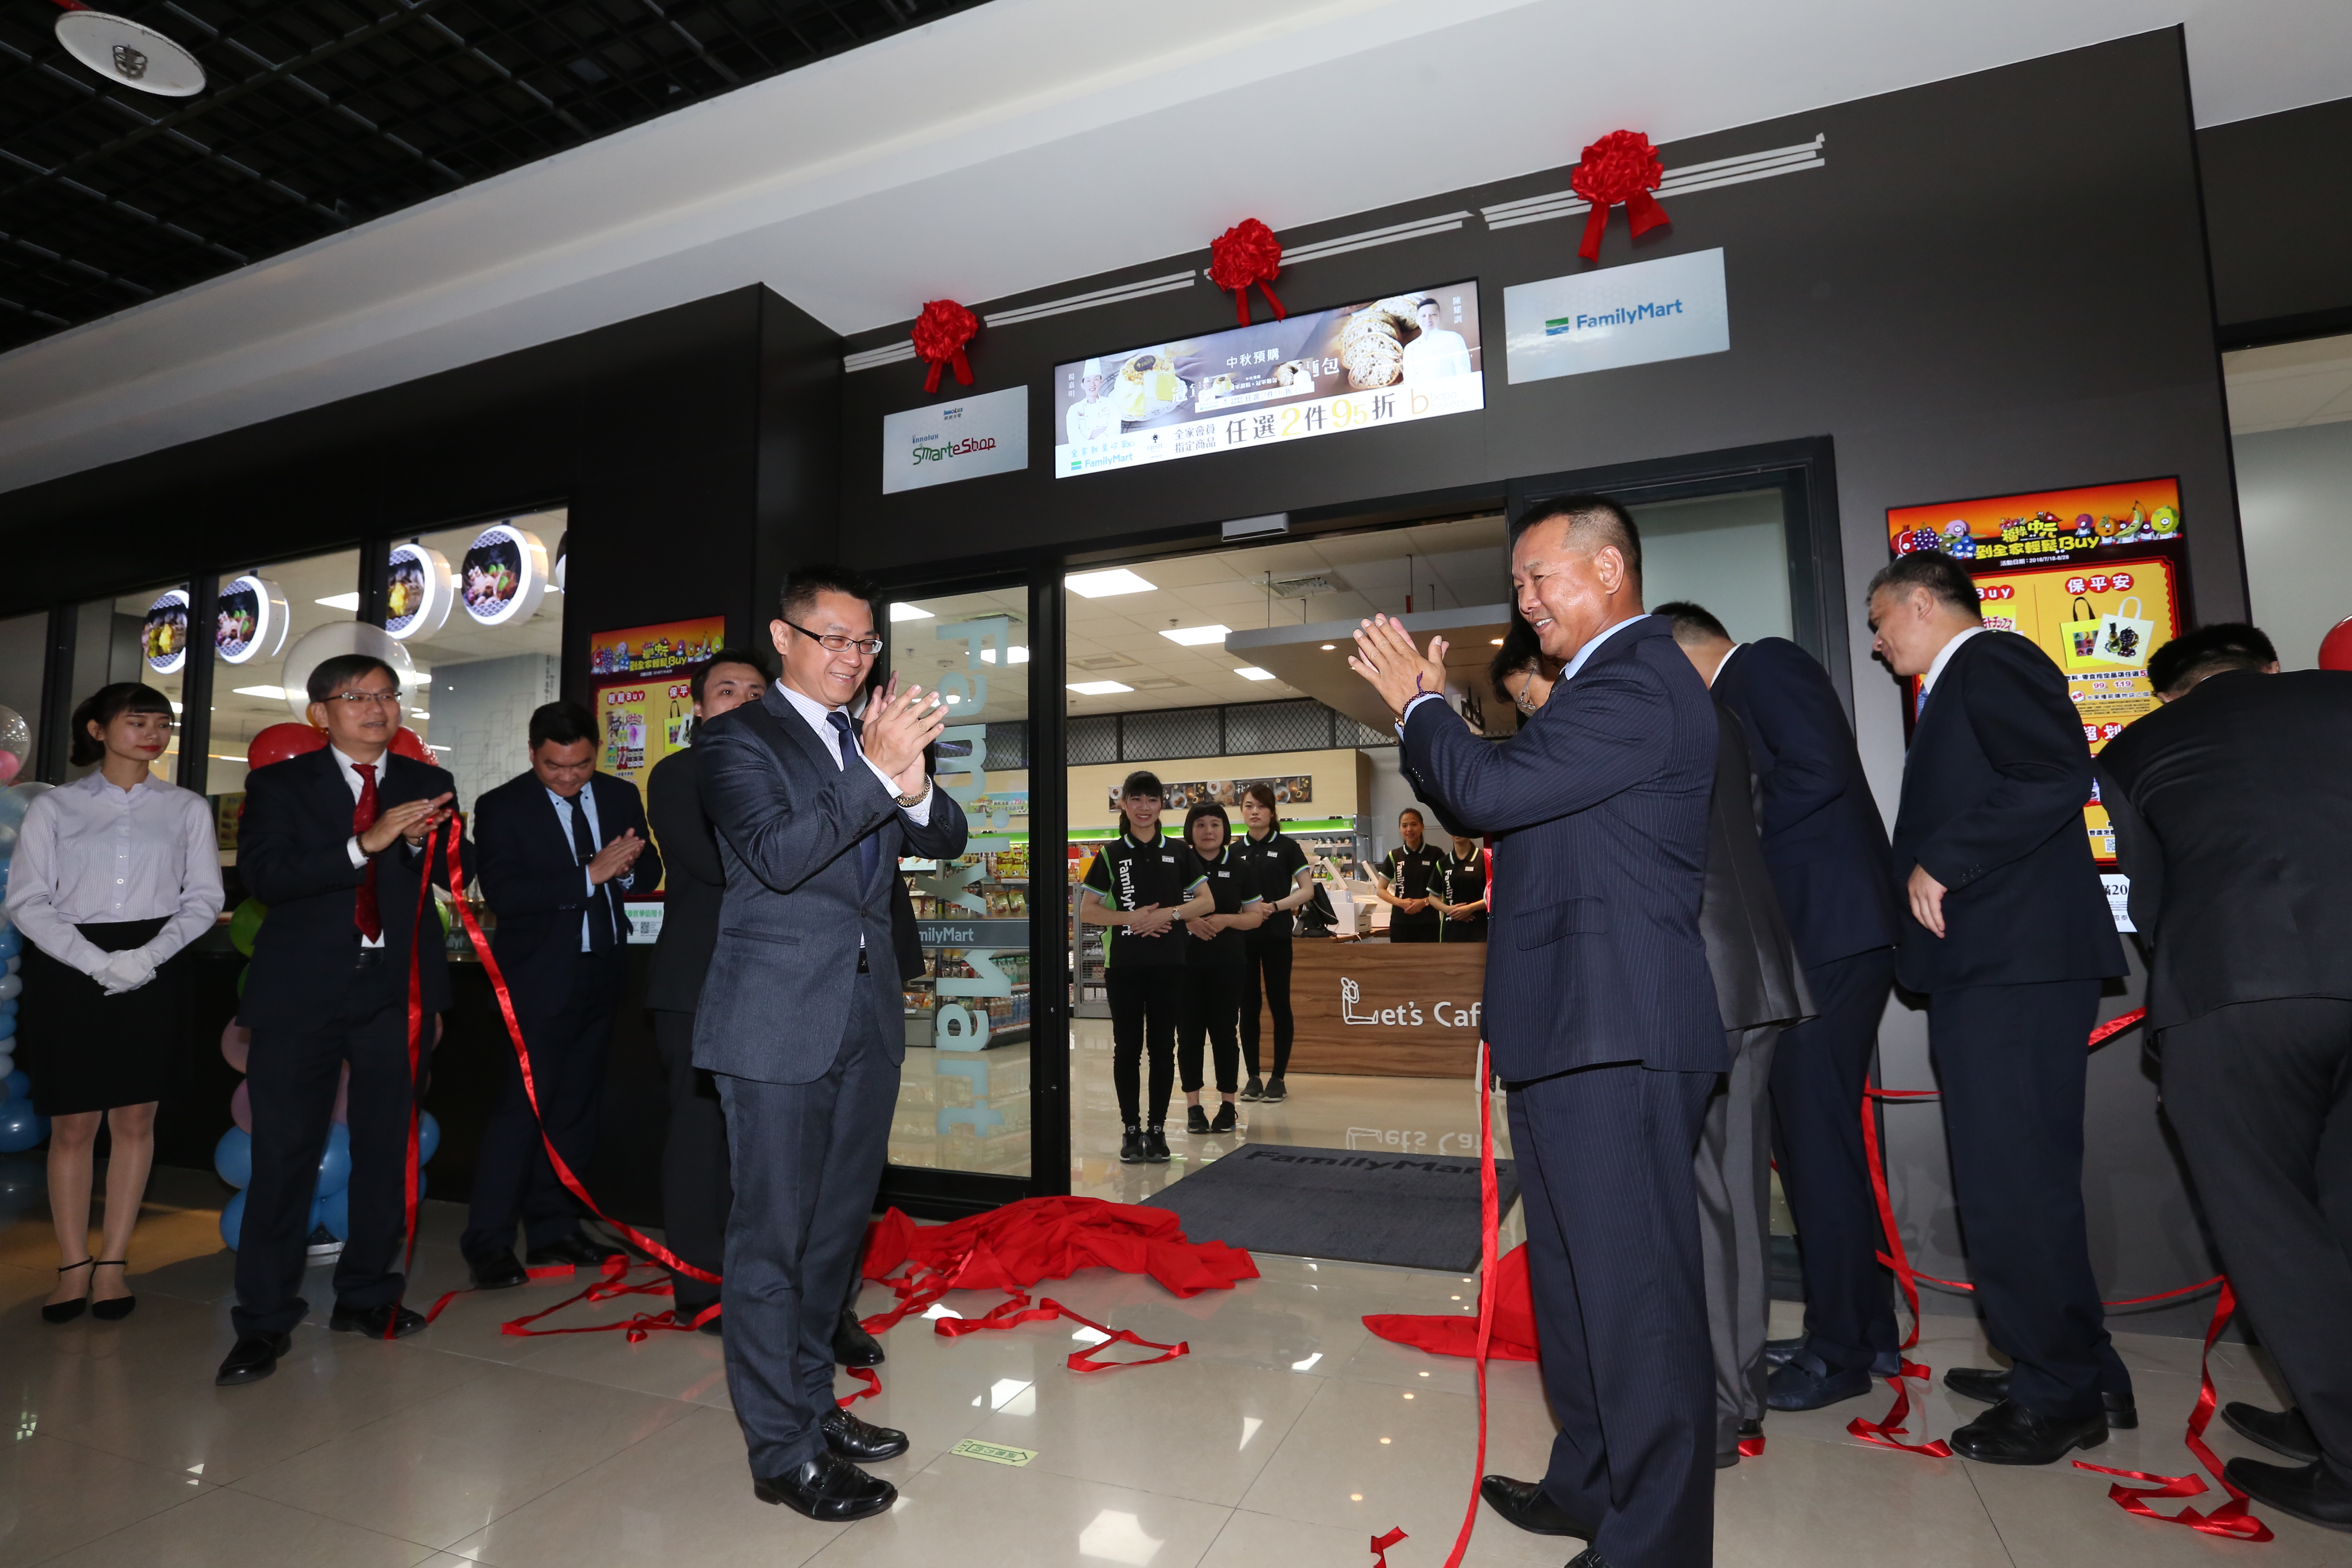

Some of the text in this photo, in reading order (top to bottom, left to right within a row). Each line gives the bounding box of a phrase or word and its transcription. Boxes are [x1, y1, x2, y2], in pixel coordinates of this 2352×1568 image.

[1577, 299, 1683, 330] FamilyMart
[1226, 347, 1280, 369] 中秋預購
[1174, 424, 1215, 440] 全家會員
[1174, 437, 1216, 454] 指定商品
[1085, 452, 1133, 468] FamilyMart
[2067, 575, 2130, 594] 保平安
[1396, 861, 1405, 898] FamilyMa
[1119, 859, 1136, 936] FamilyMrt
[1445, 869, 1453, 921] FamilyMt
[919, 927, 974, 944] milyMart
[1434, 1001, 1481, 1027] Caf
[955, 1440, 973, 1453] EXIT
